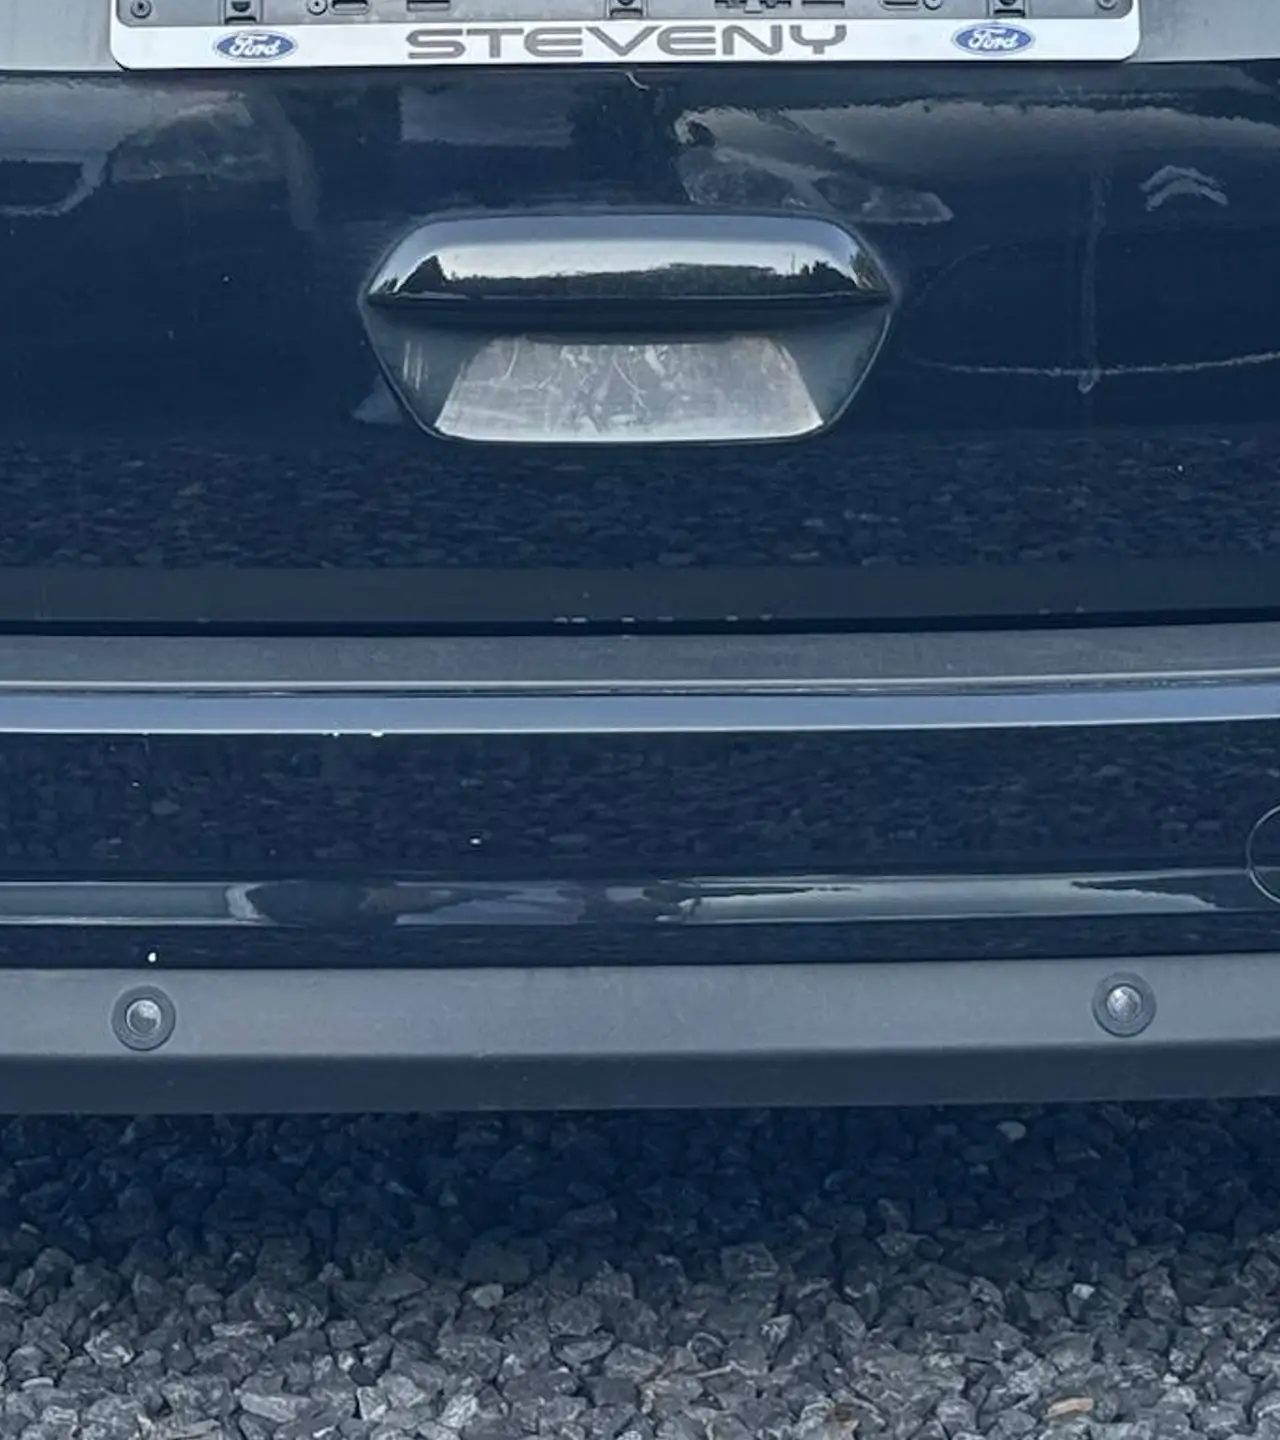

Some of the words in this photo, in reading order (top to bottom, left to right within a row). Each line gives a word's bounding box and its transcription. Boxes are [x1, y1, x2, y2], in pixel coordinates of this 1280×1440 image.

[229, 33, 281, 56] Ford
[405, 25, 847, 59] STEVENY
[969, 29, 1018, 49] Ford
